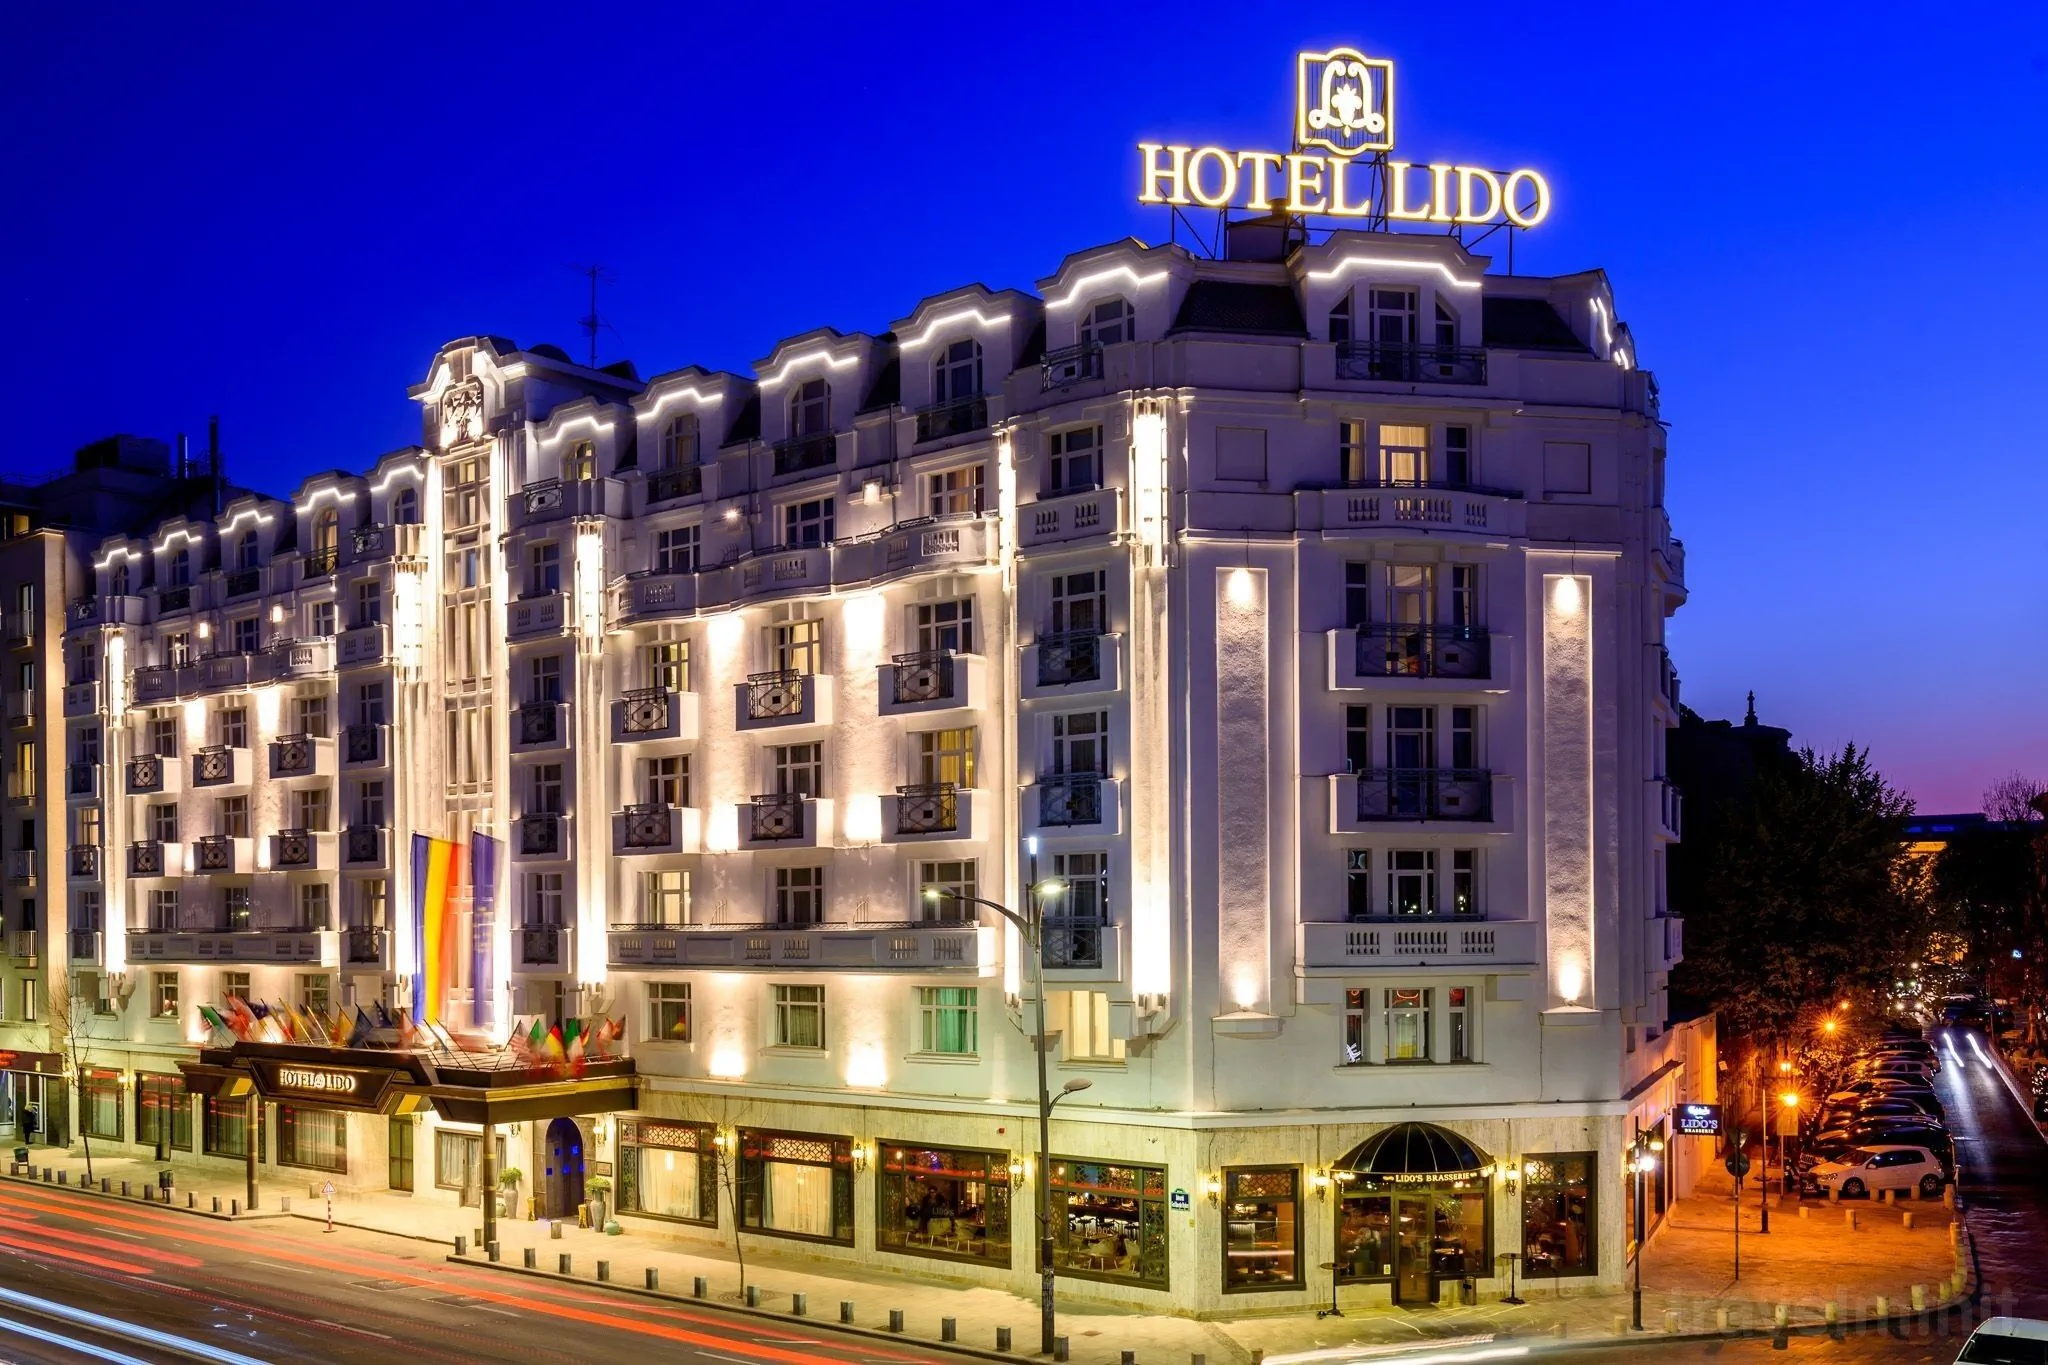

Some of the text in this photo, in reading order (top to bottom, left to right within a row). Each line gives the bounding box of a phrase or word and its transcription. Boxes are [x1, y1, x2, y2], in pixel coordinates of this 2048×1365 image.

[1137, 143, 1550, 227] HOTEL LIDO
[280, 1069, 356, 1092] HOTEL LIDO
[1681, 1119, 1718, 1129] LIDO'S
[1396, 1172, 1470, 1182] LIDO'S BRASSERIE
